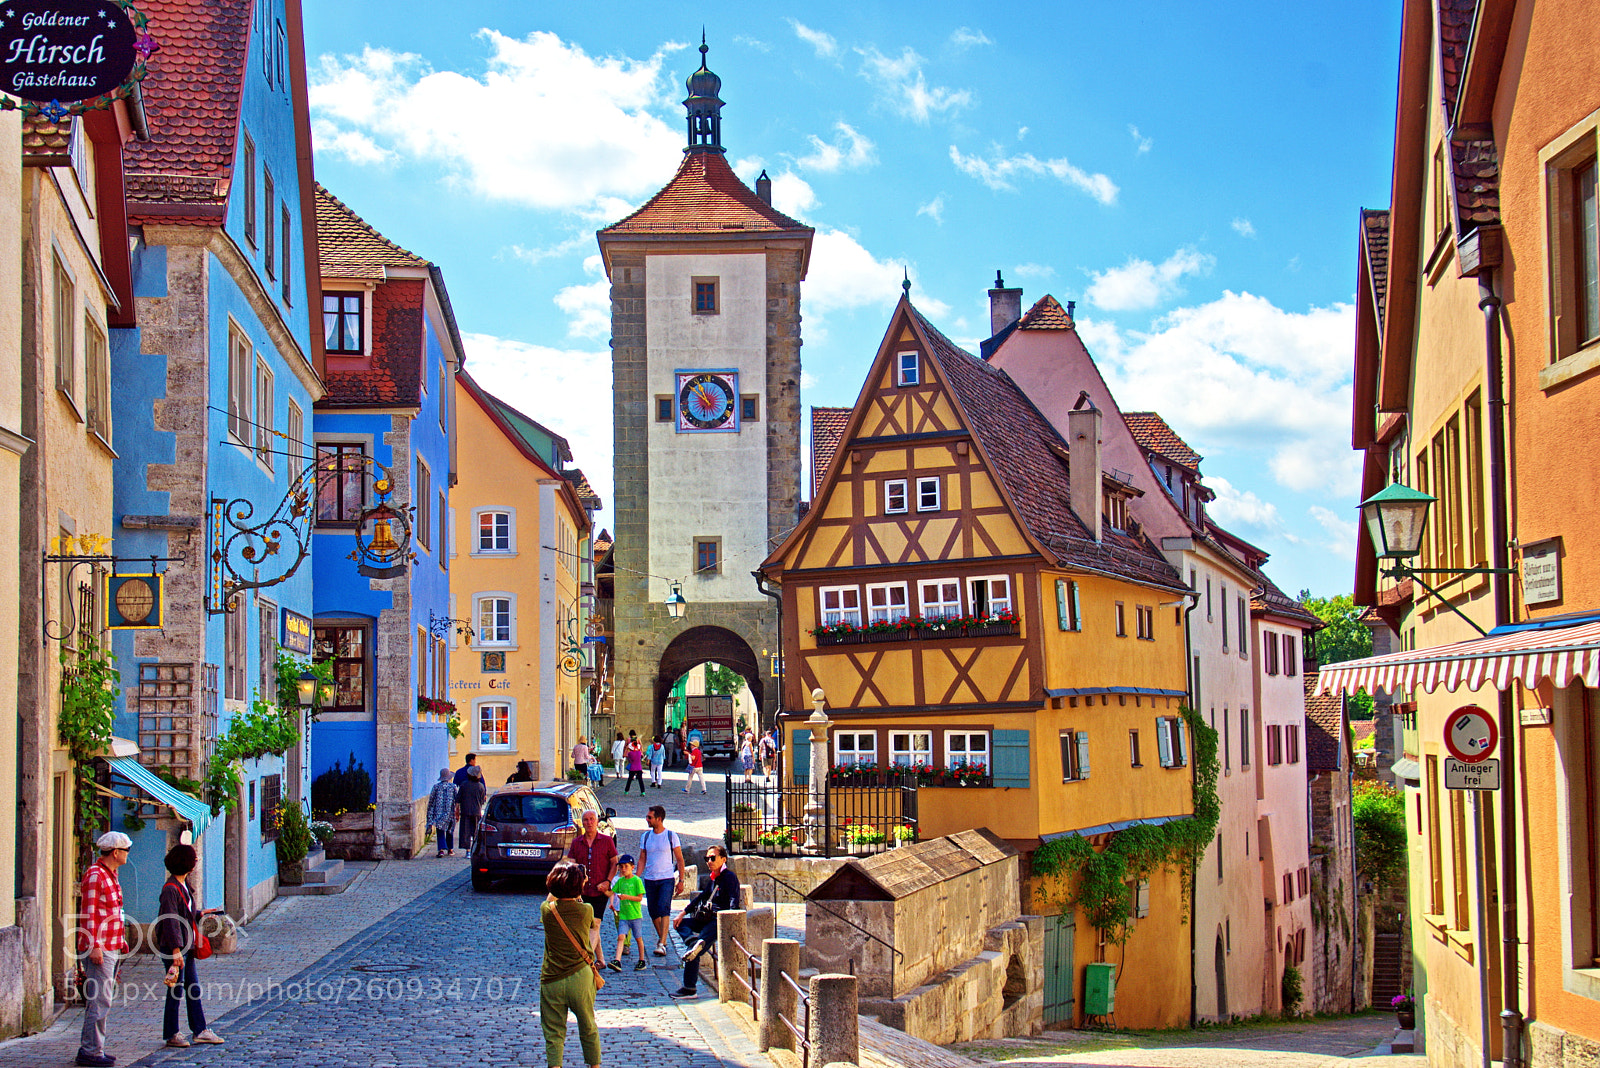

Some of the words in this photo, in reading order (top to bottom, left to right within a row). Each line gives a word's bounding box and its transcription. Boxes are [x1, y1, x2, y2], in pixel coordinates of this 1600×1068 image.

[22, 10, 90, 31] Goldener
[5, 34, 106, 64] Hirsch
[12, 69, 97, 91] Gästehaus
[1451, 763, 1493, 775] Anlieger
[1464, 775, 1481, 785] frei
